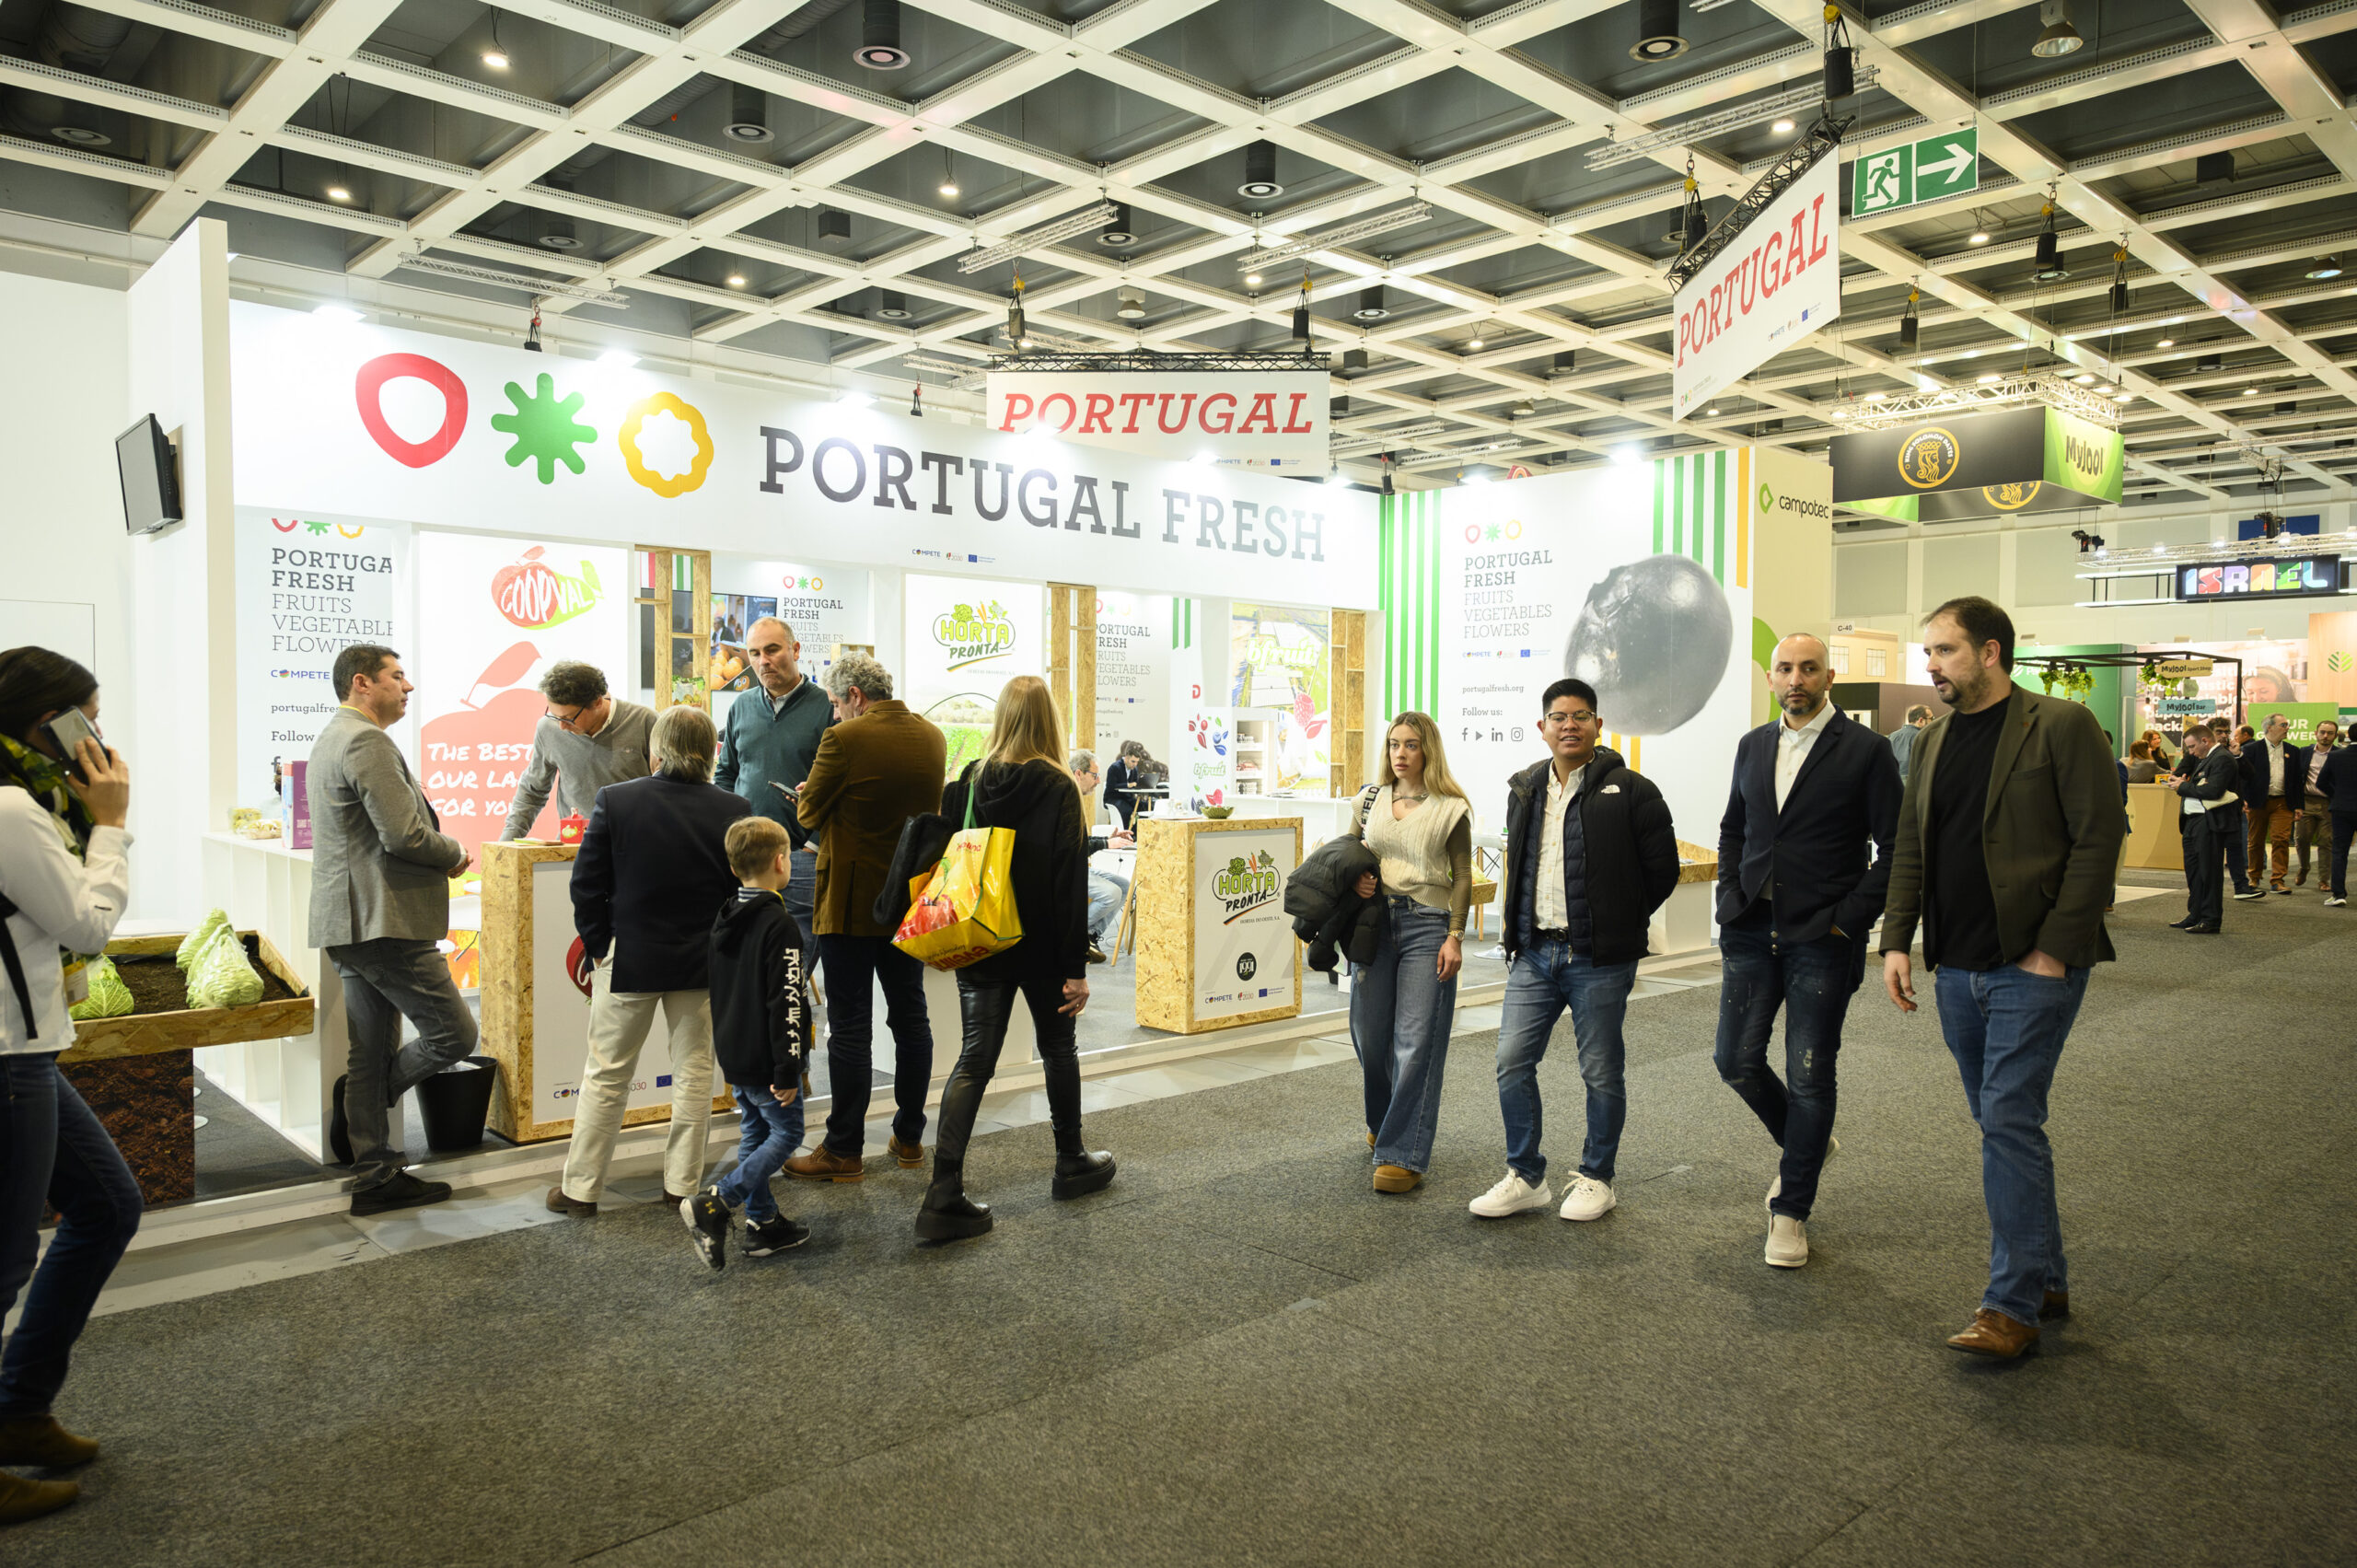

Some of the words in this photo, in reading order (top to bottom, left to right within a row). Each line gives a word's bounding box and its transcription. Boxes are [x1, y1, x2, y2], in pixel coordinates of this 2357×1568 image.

[1678, 192, 1829, 368] PORTUGAL
[999, 392, 1314, 435] PORTUGAL
[1911, 434, 1945, 447] SOLOMON
[2065, 435, 2103, 476] MyJool
[760, 425, 1141, 540] PORTUGAL
[1162, 488, 1325, 563] FRESH
[1779, 494, 1829, 518] campotec
[272, 547, 393, 575] PORTUGA
[1464, 550, 1553, 571] PORTUGAL
[272, 570, 354, 592] FRESH
[1464, 571, 1515, 587] FRESH
[2185, 561, 2328, 596] ISRAEL
[272, 593, 352, 613] FRUITS
[500, 568, 595, 623] COOPVAL
[784, 597, 843, 610] PORTUGAL
[1464, 589, 1514, 606] FRUITS
[784, 609, 819, 620] FRESH
[1464, 604, 1552, 621] VEGETABLES
[272, 614, 394, 636] VEGETABLE
[789, 621, 819, 632] RUITS
[940, 619, 1009, 645] HORTA
[1464, 622, 1530, 639] FLOWERS
[1837, 624, 1852, 633] C-40
[799, 644, 830, 654] OWERS
[949, 641, 1000, 659] PRONTA
[1096, 637, 1127, 648] RESH
[271, 669, 331, 679] COMPETE
[1096, 675, 1137, 687] LOWERS
[1462, 684, 1525, 694] portugalfresh.org
[271, 703, 340, 714] portugalfres
[1462, 707, 1489, 716] Follow
[1491, 708, 1503, 716] us:
[271, 730, 315, 742] Follow
[427, 742, 470, 761] THE
[477, 742, 535, 761] BEST
[427, 770, 479, 789] OUR
[431, 798, 477, 817] FOR
[1218, 871, 1275, 896] HORTA
[1225, 889, 1267, 912] PRONTA
[1204, 994, 1233, 1005] COMPETE
[630, 1081, 647, 1092] 030
